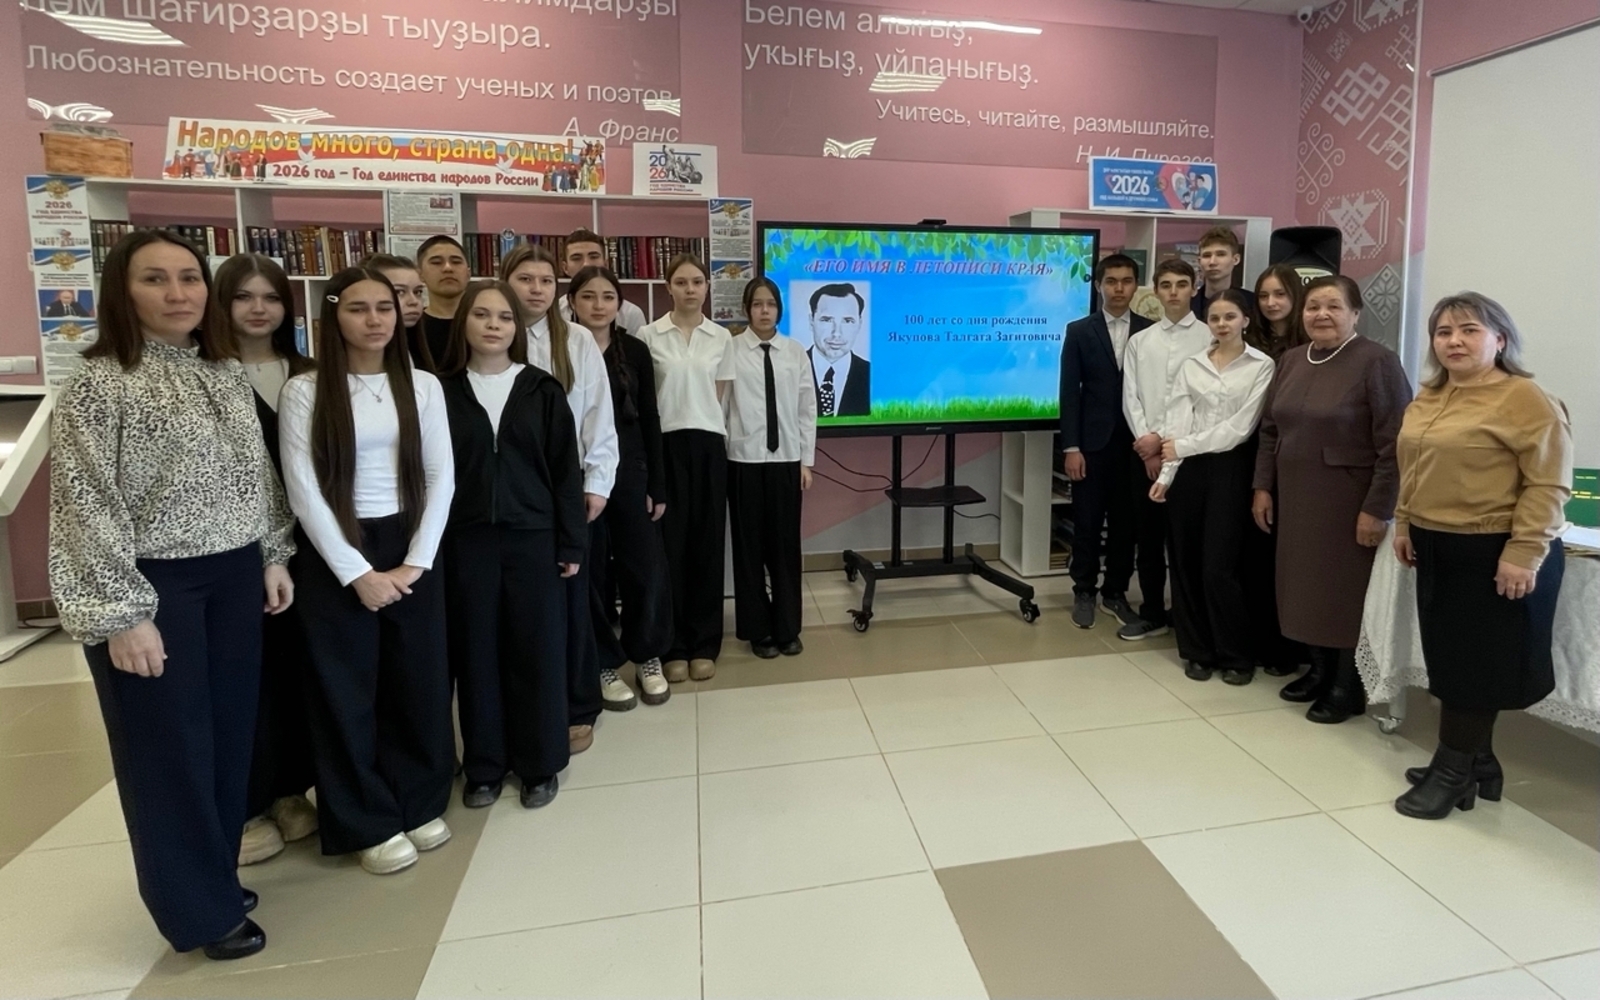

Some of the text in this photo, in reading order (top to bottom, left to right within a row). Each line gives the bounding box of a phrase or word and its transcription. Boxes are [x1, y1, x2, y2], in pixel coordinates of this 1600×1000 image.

[745, 0, 845, 31] Белем
[381, 14, 551, 53] тыуҙыра.
[744, 43, 863, 77] уҡығыҙ,
[26, 44, 326, 86] Любознательность
[335, 69, 448, 94] создает
[455, 76, 554, 100] ученых
[563, 84, 578, 100] и
[875, 98, 1215, 140] Учитесь, читайте, размышляйте.
[177, 120, 574, 165] Народов много, страна одна!
[599, 118, 680, 146] Франс
[650, 154, 667, 167] 20
[273, 164, 310, 178] 2026
[314, 169, 335, 180] год
[352, 167, 374, 181] Год
[378, 170, 436, 183] единства
[441, 173, 491, 187] народов
[495, 174, 539, 187] России
[650, 167, 667, 180] 26
[1112, 174, 1150, 195] 2026
[45, 200, 73, 209] 2026
[805, 260, 1054, 276] «ЕГО ИМЯ В ЛЕТОПИСИ КРАЯ»
[904, 315, 1047, 328] 100 лет со дня рождения
[888, 331, 1062, 344] Якупова Талгата Загитовича
